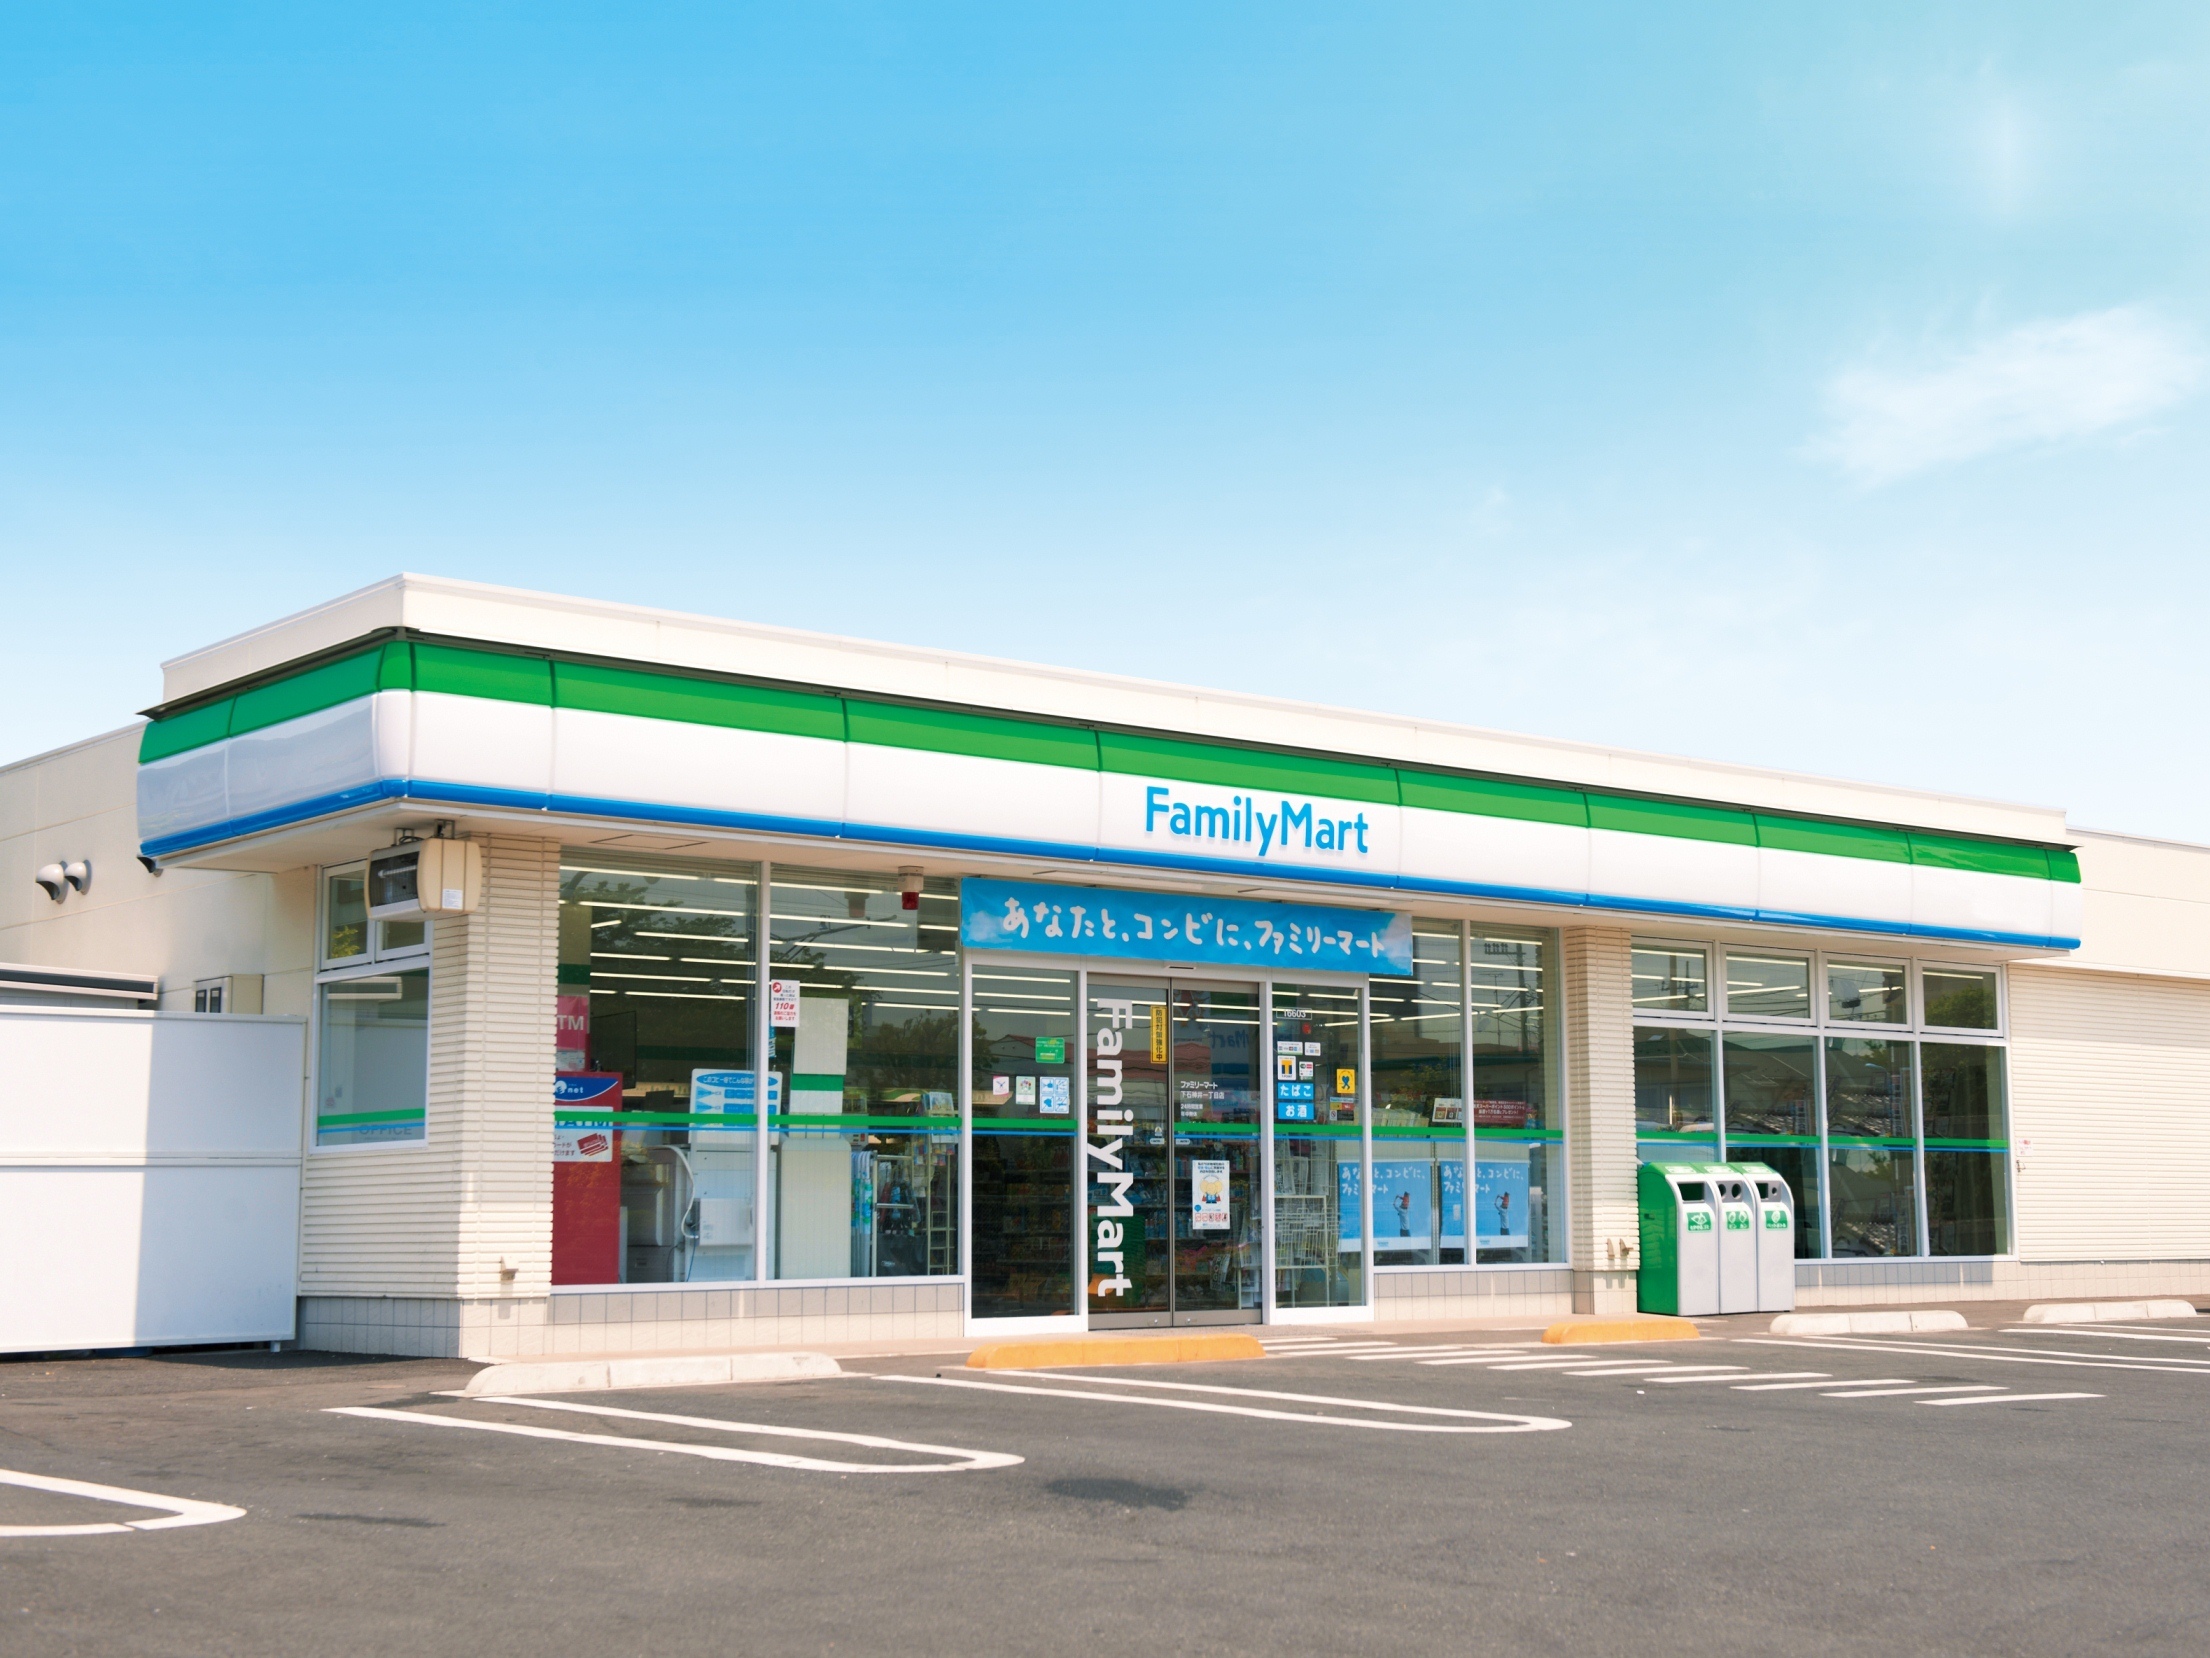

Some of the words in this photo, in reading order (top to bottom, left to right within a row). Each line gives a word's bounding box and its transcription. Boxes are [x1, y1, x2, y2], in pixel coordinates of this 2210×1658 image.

[1146, 786, 1368, 856] FamilyMart
[1002, 897, 1385, 958] あなたと、コンビに、ファミリーマート
[1180, 1081, 1218, 1090] ファミリーマート
[1280, 1084, 1311, 1097] たばこ
[1285, 1105, 1307, 1117] お酒
[1087, 998, 1134, 1298] FamilyMart
